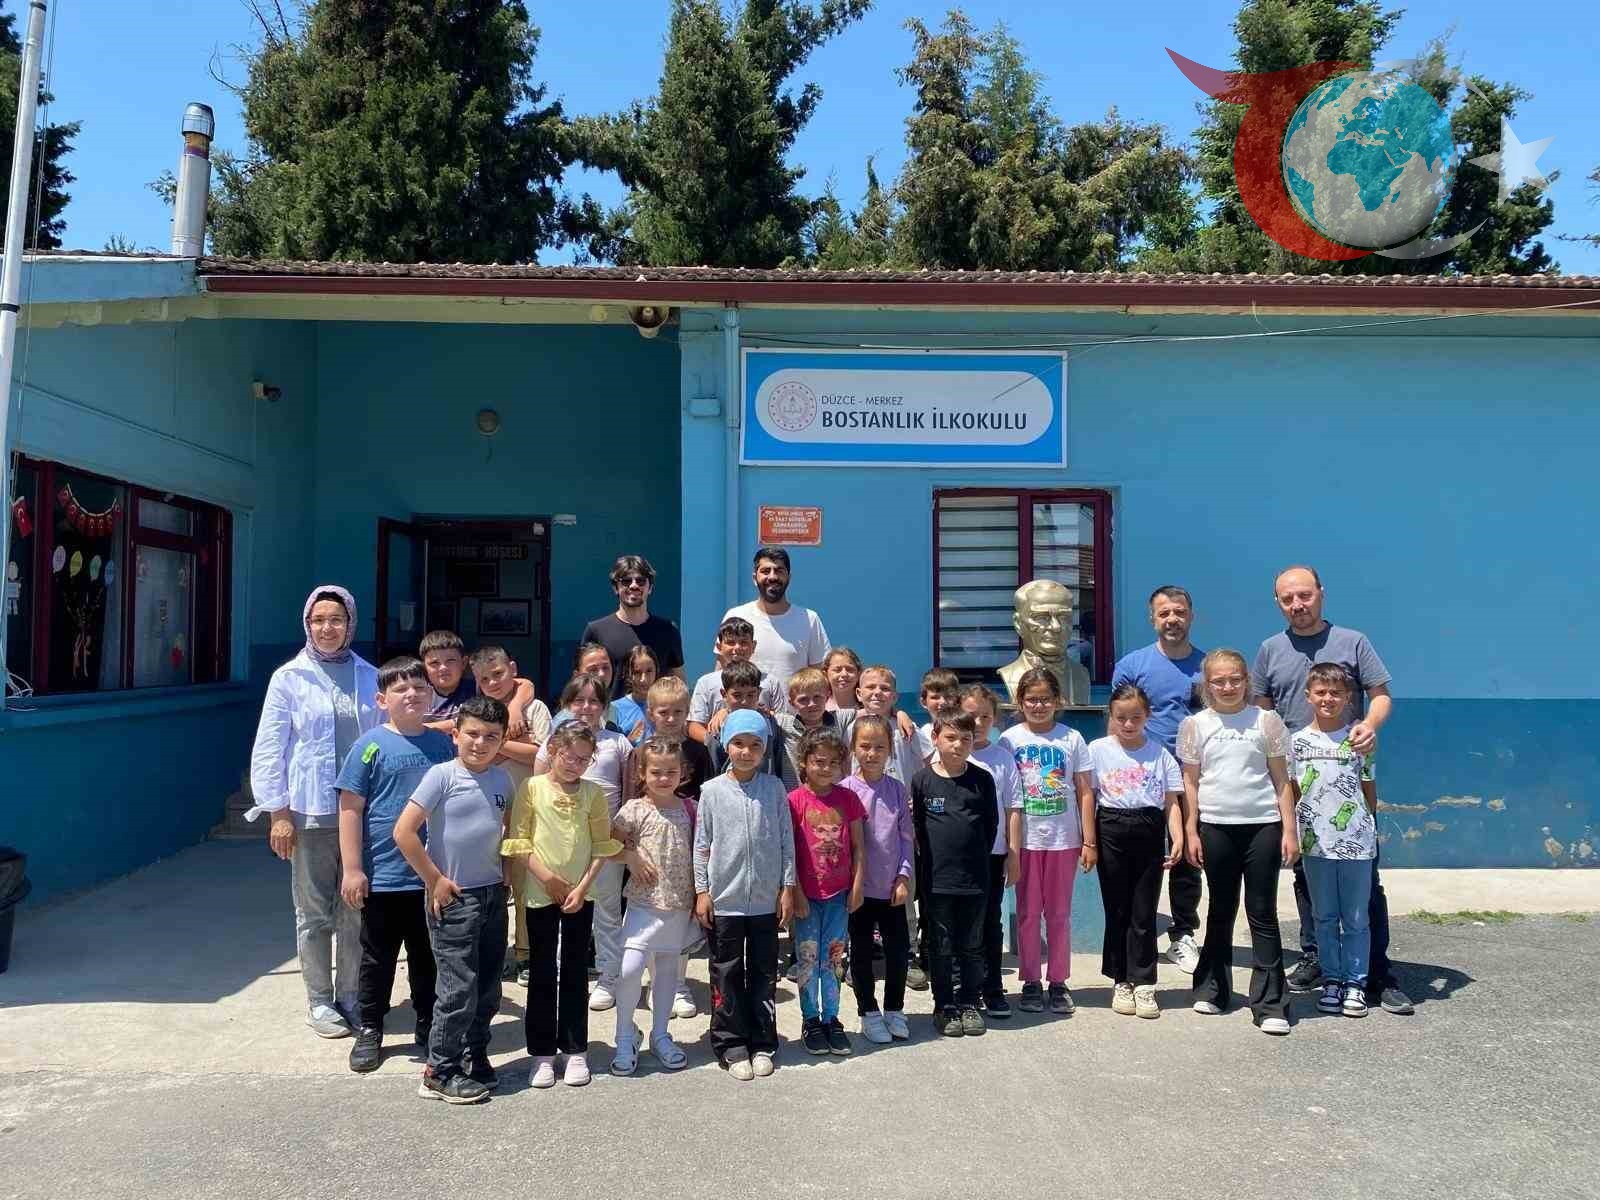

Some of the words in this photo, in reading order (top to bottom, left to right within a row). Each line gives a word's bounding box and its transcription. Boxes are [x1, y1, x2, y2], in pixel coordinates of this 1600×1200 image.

[821, 394, 856, 405] DÜZCE
[865, 395, 904, 406] MERKEZ
[822, 410, 925, 429] BOSTANLIK
[932, 407, 1027, 430] İLKOKULU
